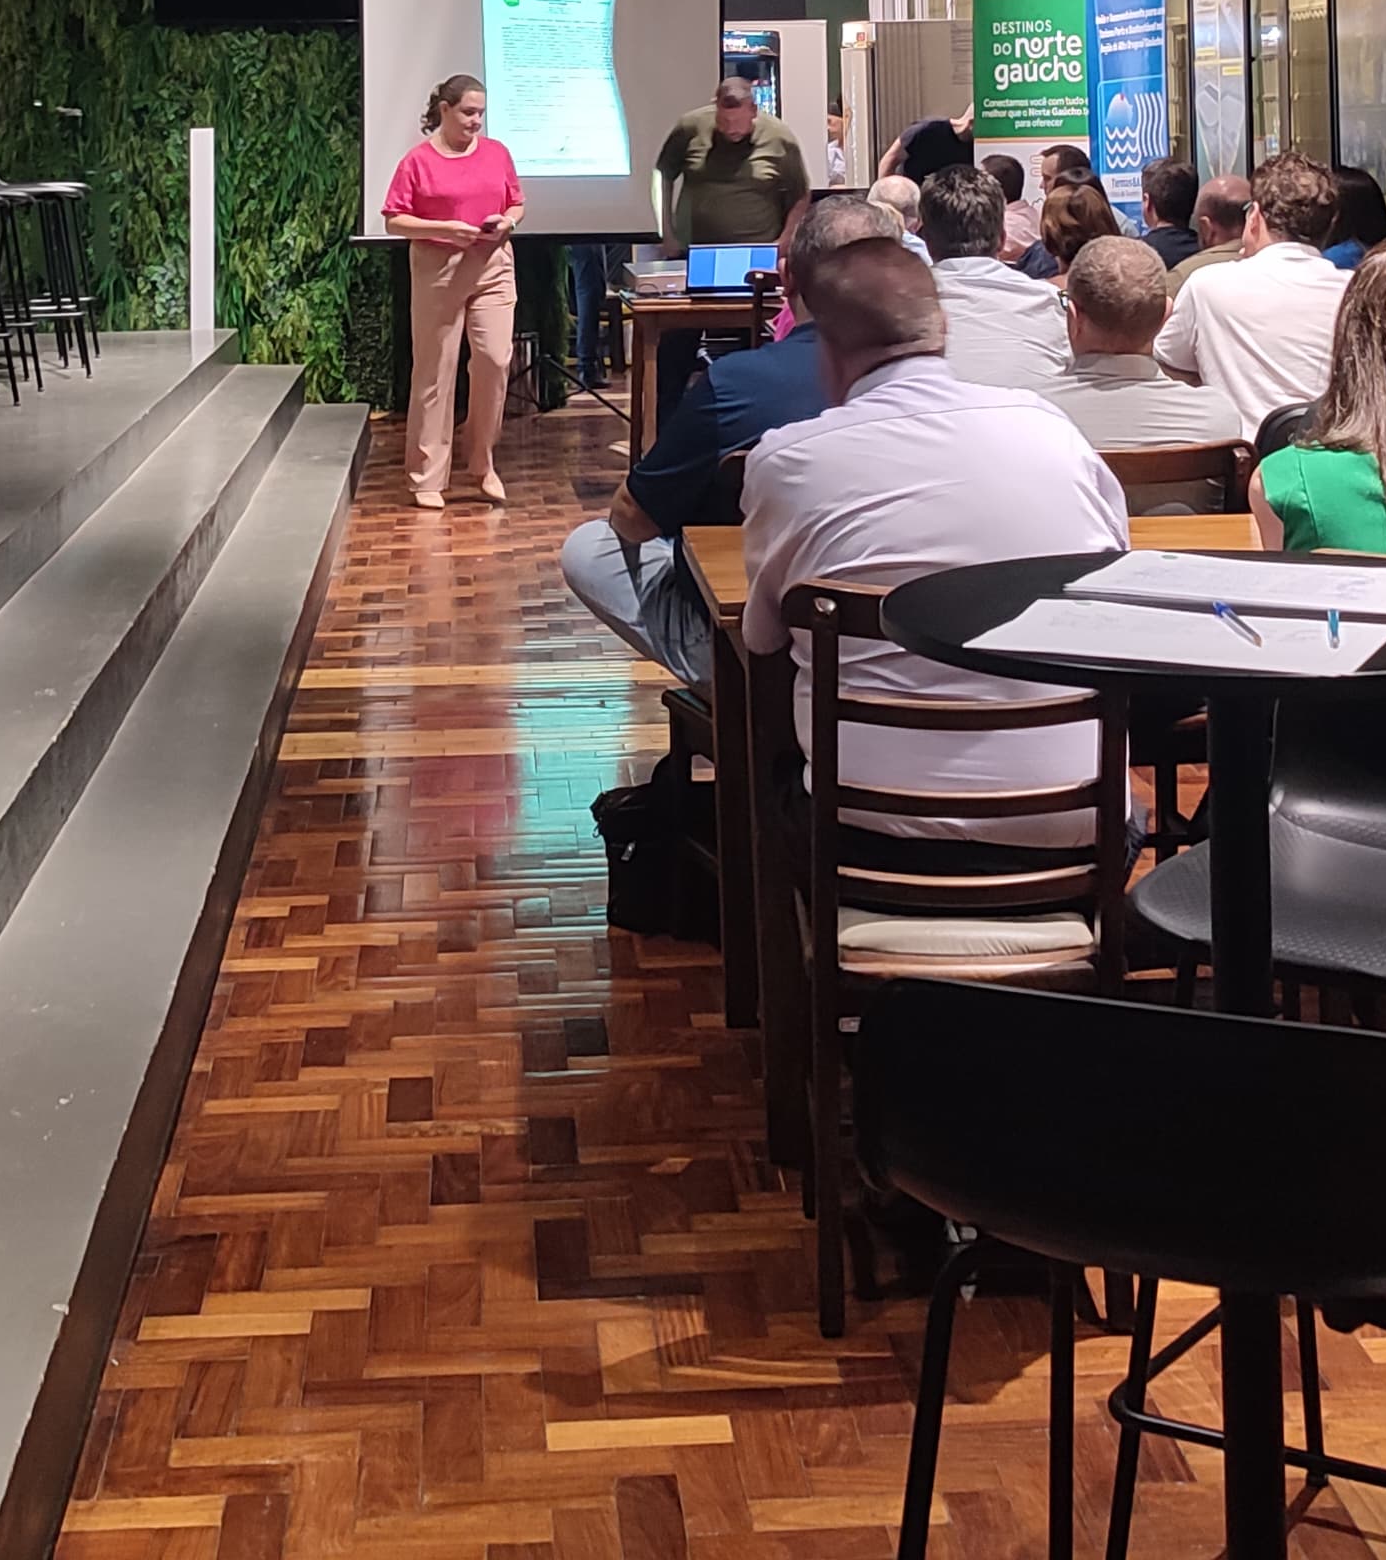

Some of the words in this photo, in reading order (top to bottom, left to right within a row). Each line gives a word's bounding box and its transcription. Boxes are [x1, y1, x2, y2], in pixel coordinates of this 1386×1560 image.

[992, 19, 1052, 35] DESTINOS
[993, 42, 1012, 56] DO
[1015, 30, 1083, 58] norte
[994, 55, 1083, 91] gaúcho
[1014, 120, 1031, 130] para
